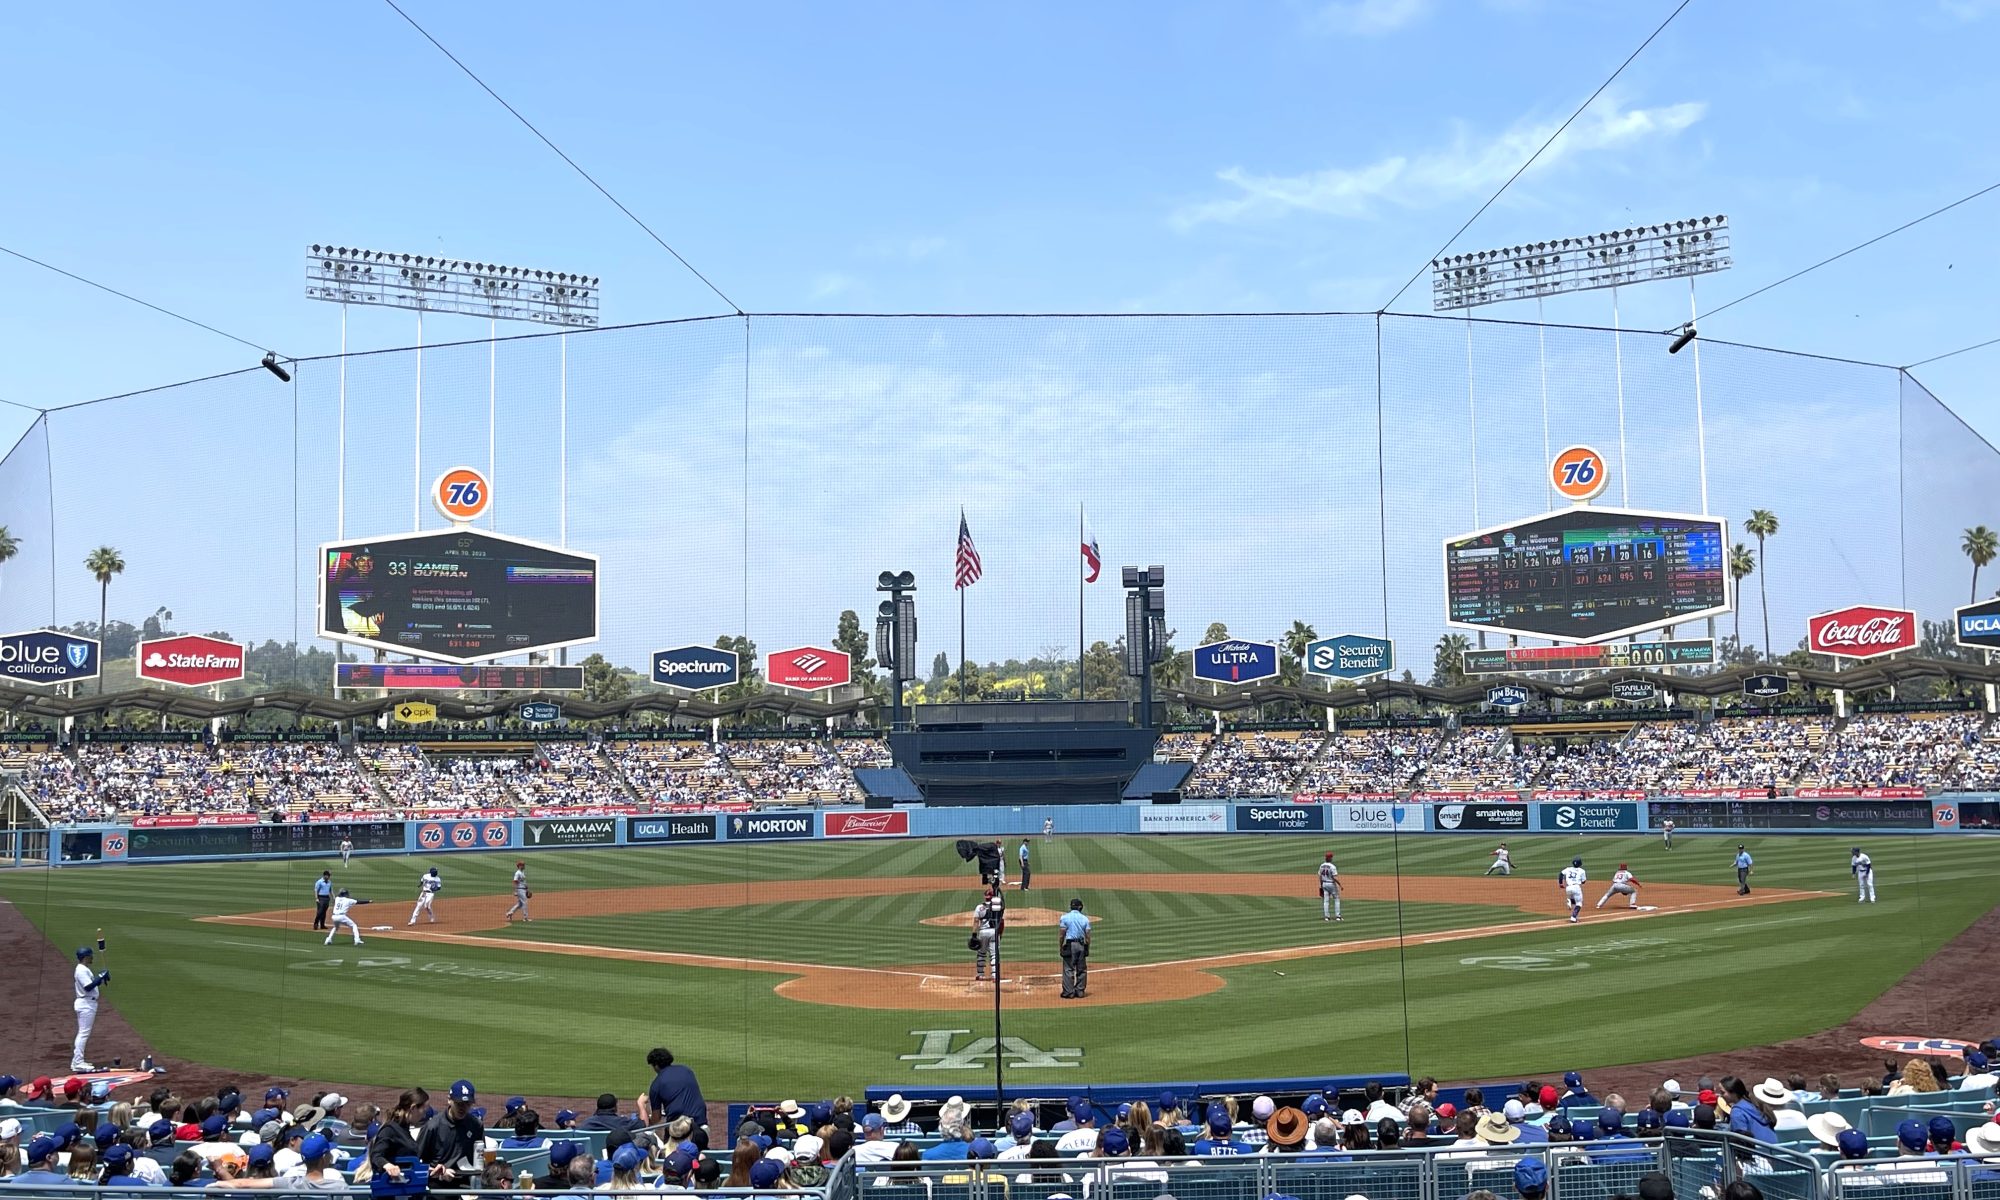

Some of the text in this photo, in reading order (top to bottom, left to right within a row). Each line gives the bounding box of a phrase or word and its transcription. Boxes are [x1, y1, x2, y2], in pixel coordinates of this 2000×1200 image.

[1561, 457, 1596, 486] 76
[446, 481, 481, 506] 76
[1600, 553, 1604, 562] 7
[1620, 552, 1630, 560] 20
[1642, 550, 1652, 558] 16
[388, 562, 407, 576] 33
[414, 562, 459, 570] JAMES
[414, 570, 468, 578] OUTMAN
[1644, 571, 1652, 580] 93
[1528, 578, 1537, 588] 17
[1552, 578, 1556, 586] 7
[1964, 618, 2000, 632] UCLA
[1818, 616, 1904, 647] Coca-Cola
[0, 640, 60, 663] blue
[1339, 644, 1386, 658] Security
[1614, 645, 1618, 654] 3
[1655, 648, 1664, 662] 0
[1211, 652, 1258, 664] ULTRA
[1614, 658, 1628, 666] 2 0
[1632, 650, 1640, 664] 0
[1644, 650, 1652, 664] 0
[8, 664, 66, 674] california
[658, 660, 728, 676] Spectrum
[1340, 658, 1380, 669] Benefit
[1614, 684, 1652, 692] STARLUX
[1490, 688, 1526, 702] JIM BEAM
[414, 708, 431, 718] cpk
[535, 706, 556, 714] Security
[1780, 706, 1818, 715] proflowers
[3, 732, 46, 742] proflowers
[234, 732, 272, 742] proflowers
[290, 732, 326, 742] proflowers
[663, 732, 696, 740] proflowers
[1250, 808, 1305, 822] Spectrum
[1350, 807, 1386, 822] blue
[1580, 806, 1620, 818] Security
[1834, 808, 1924, 823] Security Benefit
[1936, 809, 1954, 823] 76
[748, 819, 806, 833] MORTON
[846, 816, 886, 829] Budweiser
[1278, 820, 1302, 828] mobile
[1580, 817, 1616, 828] Benefit
[423, 826, 442, 842] 76
[454, 826, 473, 841] 76
[486, 826, 504, 840] 76
[638, 824, 664, 834] UCLA
[672, 824, 708, 834] Health
[106, 837, 124, 852] 76
[151, 834, 238, 847] Security Benefit
[900, 1029, 1083, 1069] LA
[1211, 1147, 1238, 1156] BETTS
